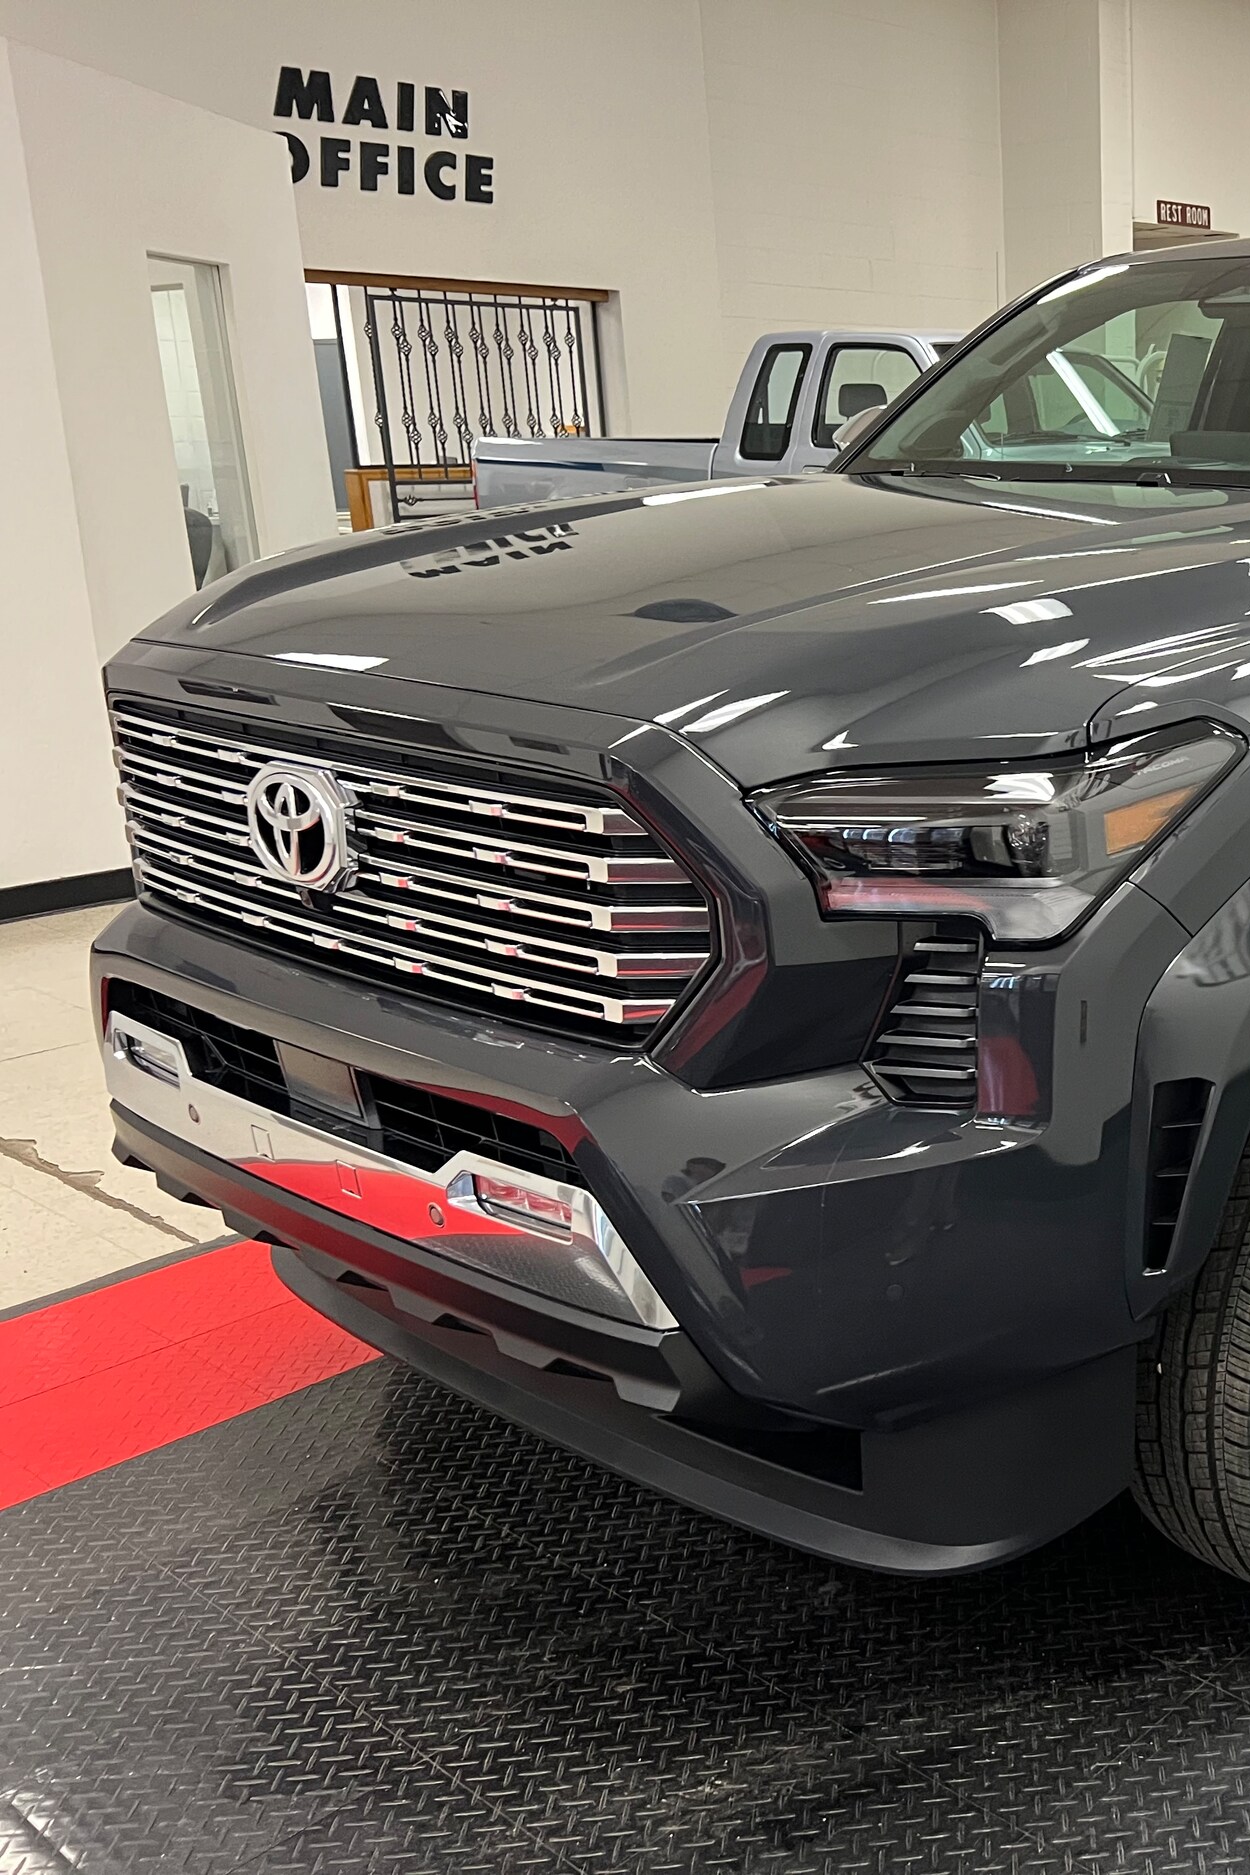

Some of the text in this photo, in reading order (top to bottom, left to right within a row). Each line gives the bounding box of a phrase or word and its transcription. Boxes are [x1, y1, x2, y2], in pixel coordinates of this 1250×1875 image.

[273, 66, 469, 139] MAIN
[1160, 203, 1209, 226] REST ROOM
[1132, 757, 1190, 776] TACOMA
